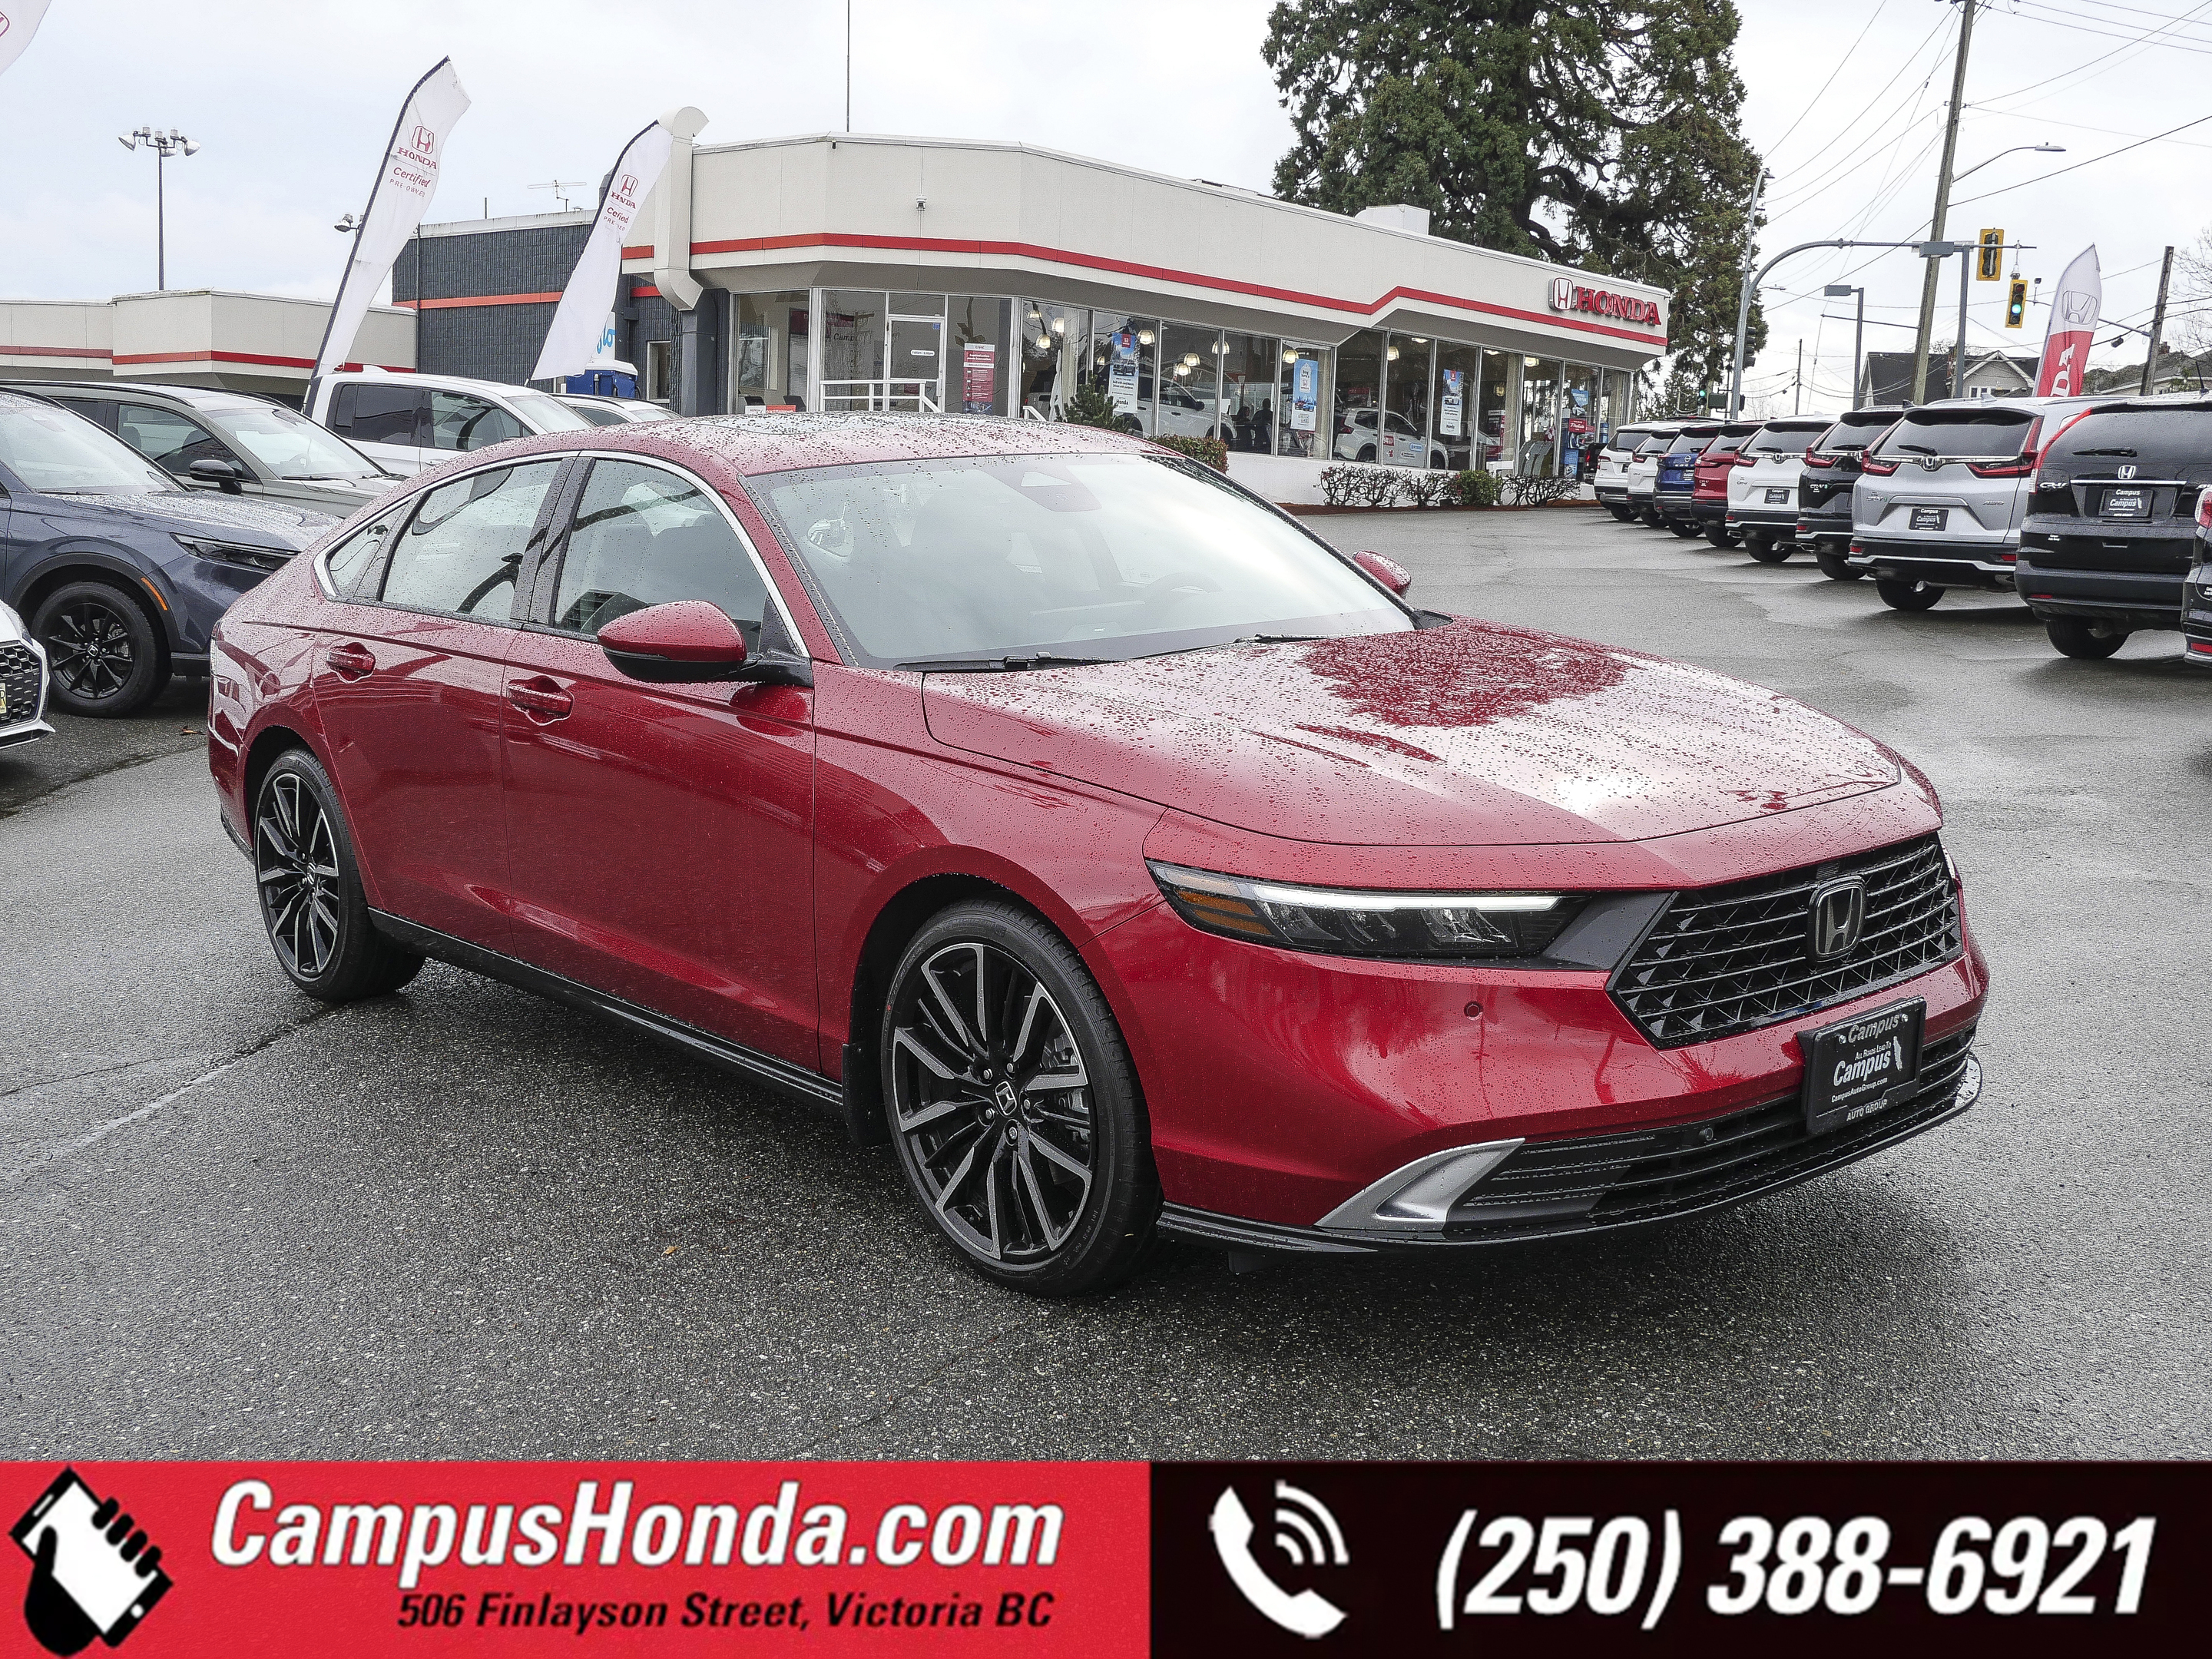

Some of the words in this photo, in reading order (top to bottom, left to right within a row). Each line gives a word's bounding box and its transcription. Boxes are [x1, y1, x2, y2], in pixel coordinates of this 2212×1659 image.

[396, 146, 437, 170] HONDA
[389, 178, 426, 197] PRE-OWNED
[393, 167, 431, 188] Certified
[1575, 286, 1661, 326] HONDA
[2110, 498, 2137, 508] Campus
[1847, 1014, 1900, 1043] Campus
[1833, 1050, 1892, 1087] Campus
[1831, 1077, 1888, 1103] CampusAutoGroup.com
[1846, 1106, 1864, 1121] AUTO
[1865, 1098, 1888, 1113] GROUP
